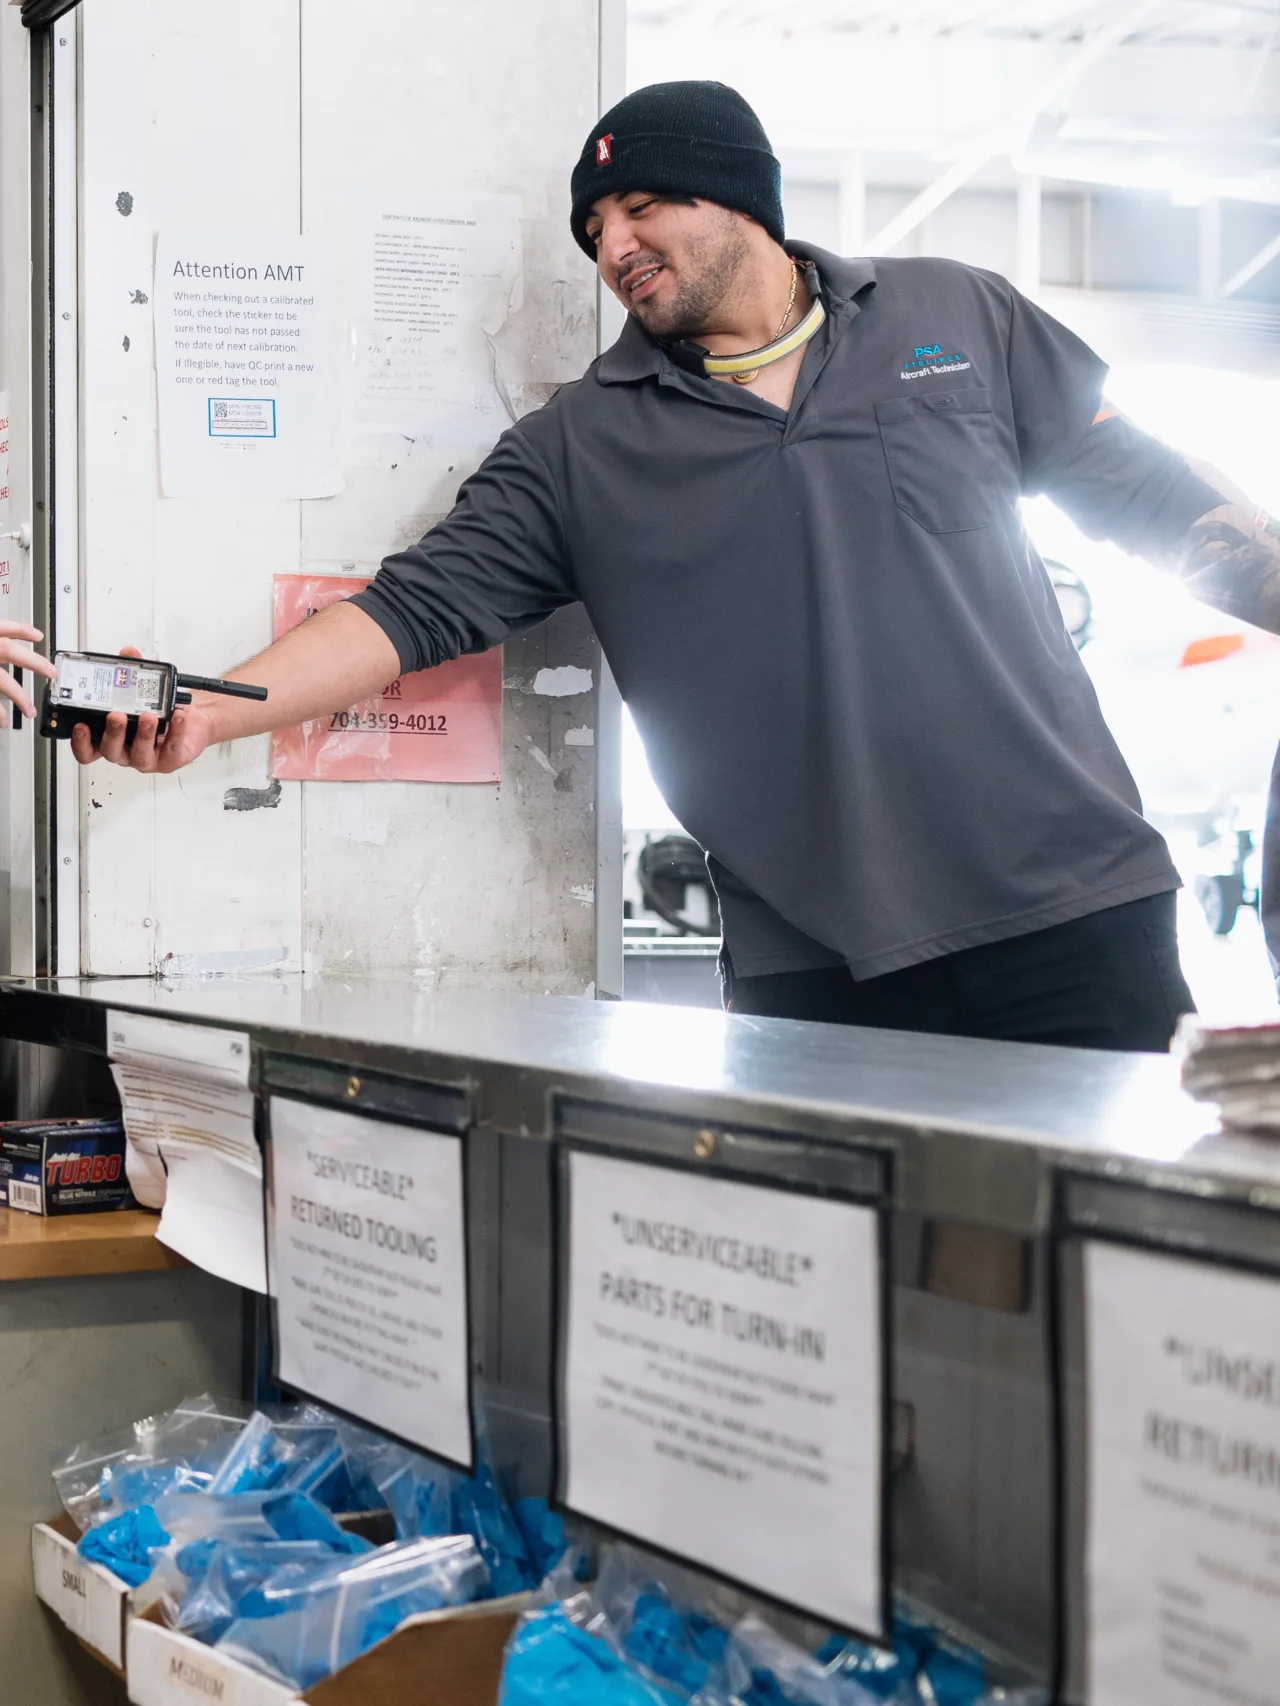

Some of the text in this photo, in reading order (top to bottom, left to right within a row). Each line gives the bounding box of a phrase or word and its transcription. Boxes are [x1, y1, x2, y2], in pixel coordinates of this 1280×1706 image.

[173, 260, 305, 282] Attention AMT
[174, 292, 201, 301] When
[203, 293, 242, 305] checking
[245, 295, 260, 304] out
[270, 295, 314, 306] calibrated
[174, 308, 298, 321] tool, check the sticker to be
[174, 325, 300, 338] sure the tool has not passed
[174, 340, 299, 353] the date of next calibration.
[914, 343, 942, 359] PSA
[175, 359, 182, 368] If
[224, 360, 246, 369] have
[248, 361, 263, 371] QC
[264, 361, 286, 372] print
[295, 364, 314, 372] new
[900, 361, 971, 380] Aircraft Technician
[904, 354, 961, 370] AIRLINES
[175, 376, 280, 387] one or red tag the tool.
[329, 711, 448, 732] 704-359-4012
[46, 1153, 122, 1187] TURBO
[291, 1194, 438, 1264] RETURNED TOOLING
[600, 1270, 826, 1364] PARTS FOR TURN-IN
[62, 1569, 87, 1599] SMALL
[170, 1657, 225, 1703] MEDIUM
